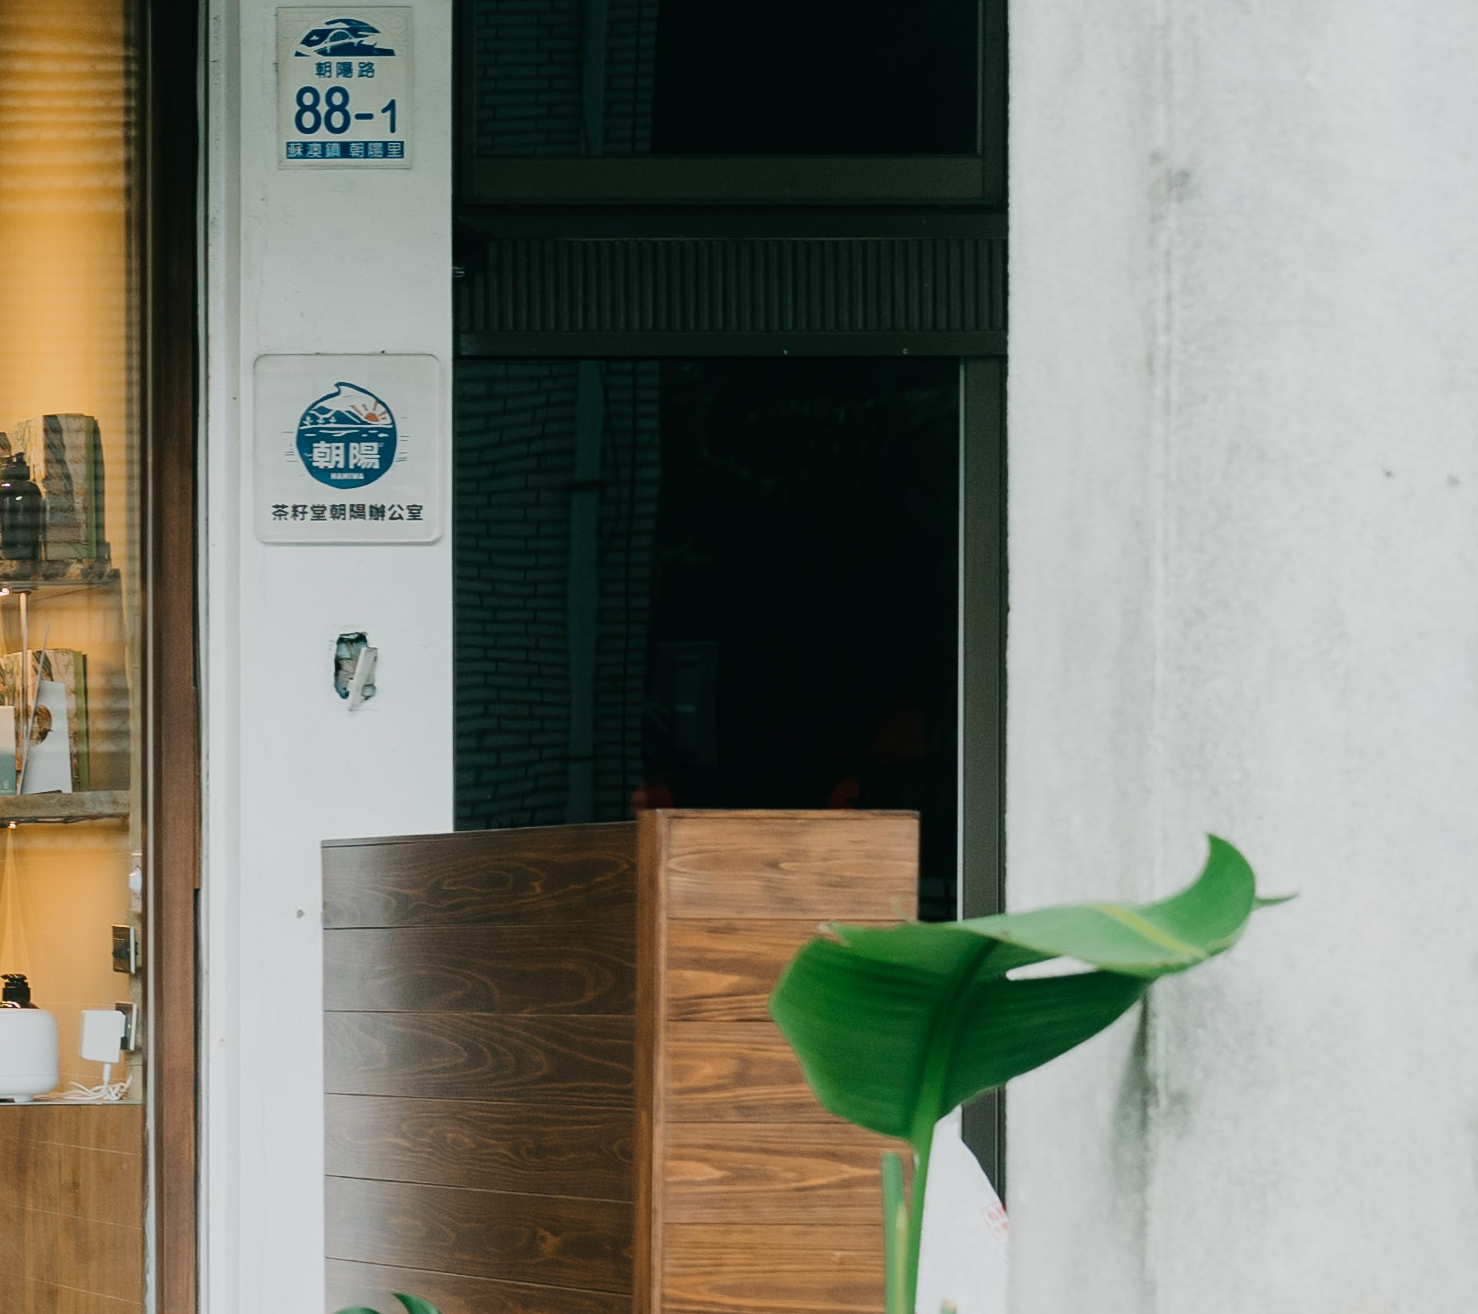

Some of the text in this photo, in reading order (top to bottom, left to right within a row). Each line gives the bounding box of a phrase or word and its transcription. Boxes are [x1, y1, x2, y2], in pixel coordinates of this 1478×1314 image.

[314, 61, 375, 79] 朝陽路
[294, 86, 397, 135] 88-1
[311, 440, 381, 469] 朝陽
